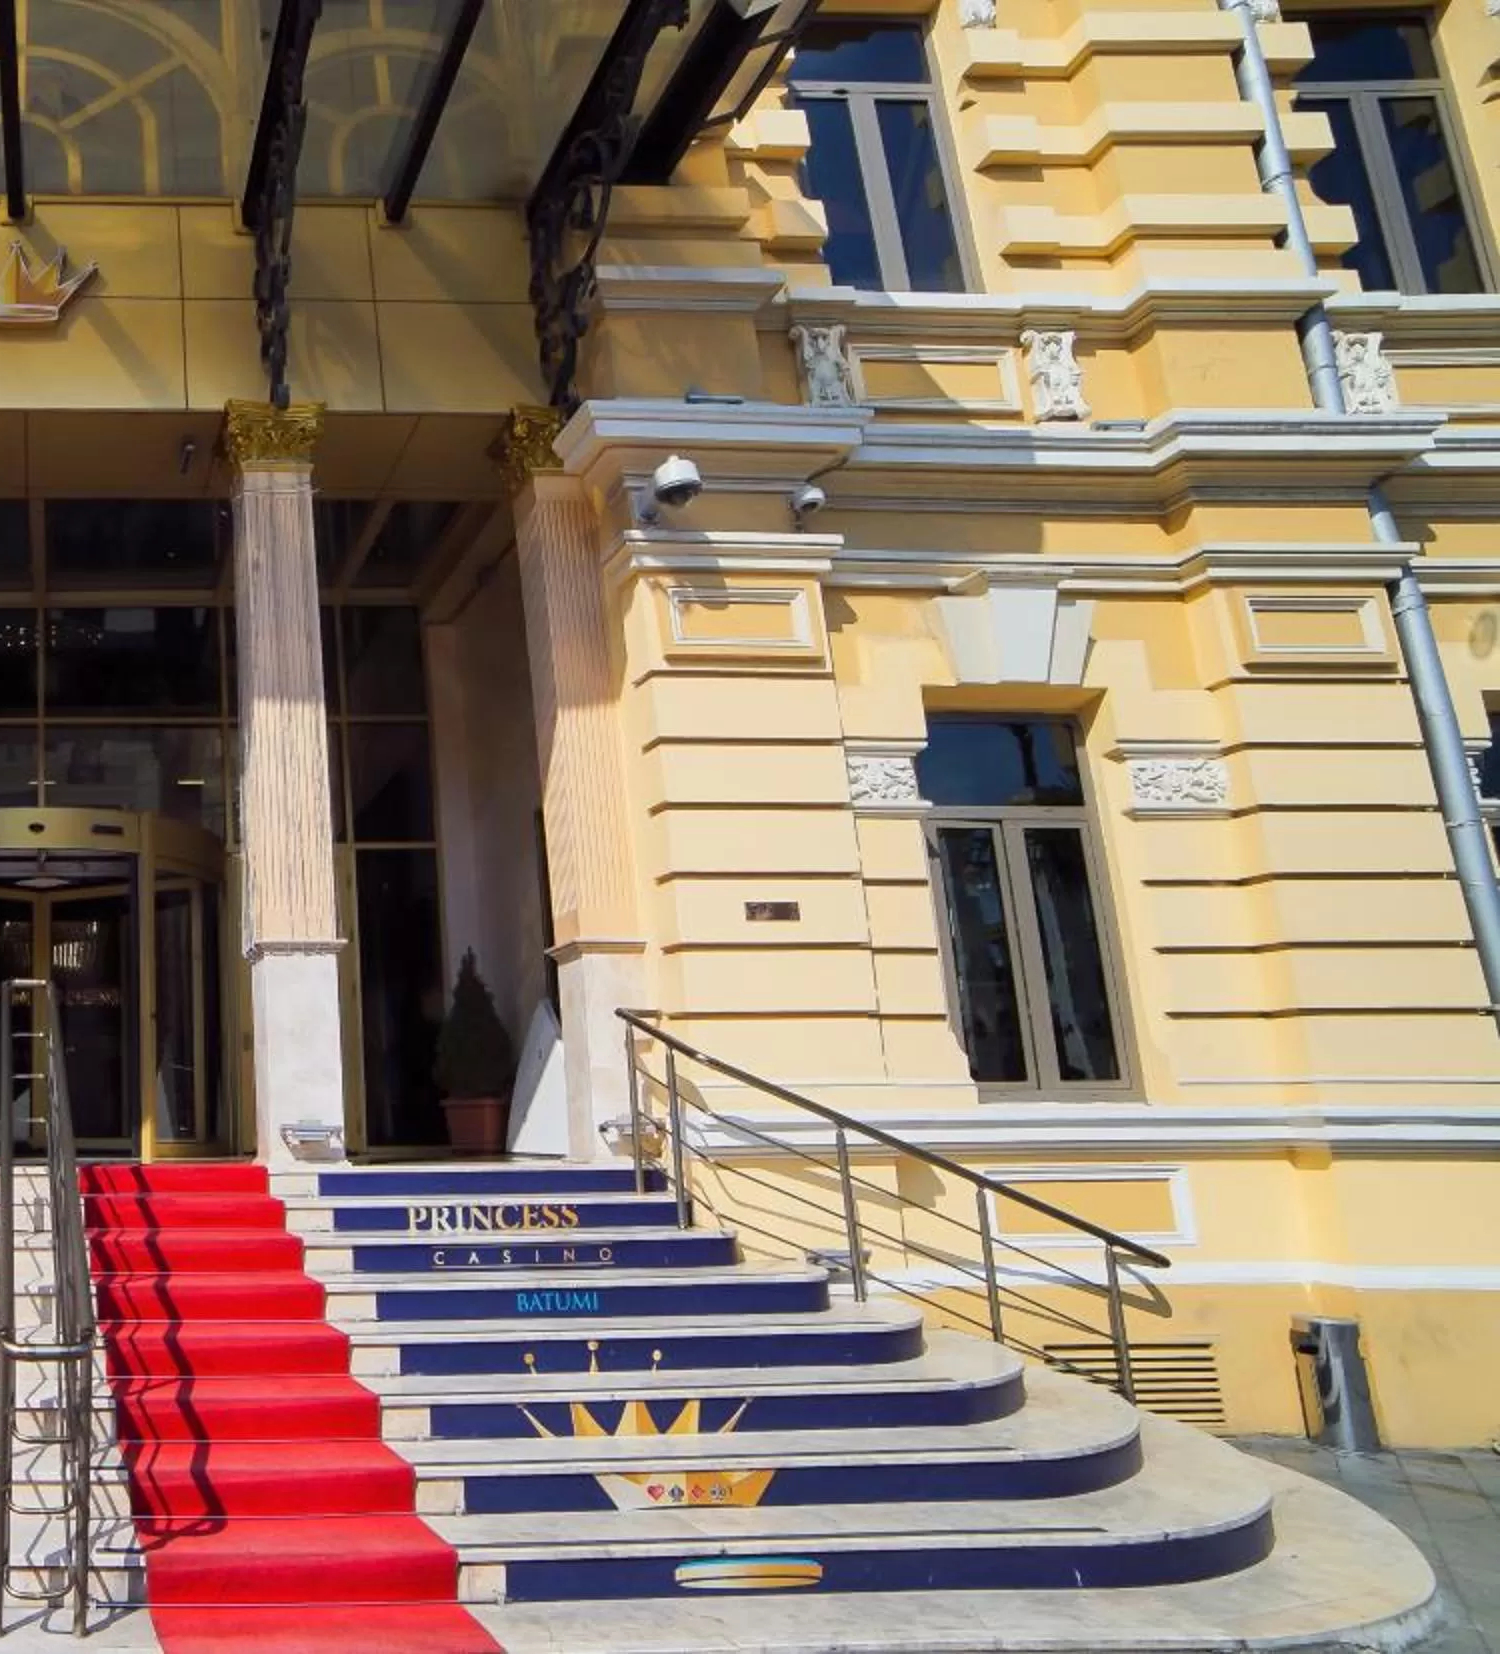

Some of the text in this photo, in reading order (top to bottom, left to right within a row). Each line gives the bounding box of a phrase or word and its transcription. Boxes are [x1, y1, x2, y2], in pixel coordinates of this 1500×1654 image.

[407, 1204, 580, 1235] PRINCESS
[433, 1247, 612, 1265] CASINO
[516, 1291, 599, 1312] BATUMI
